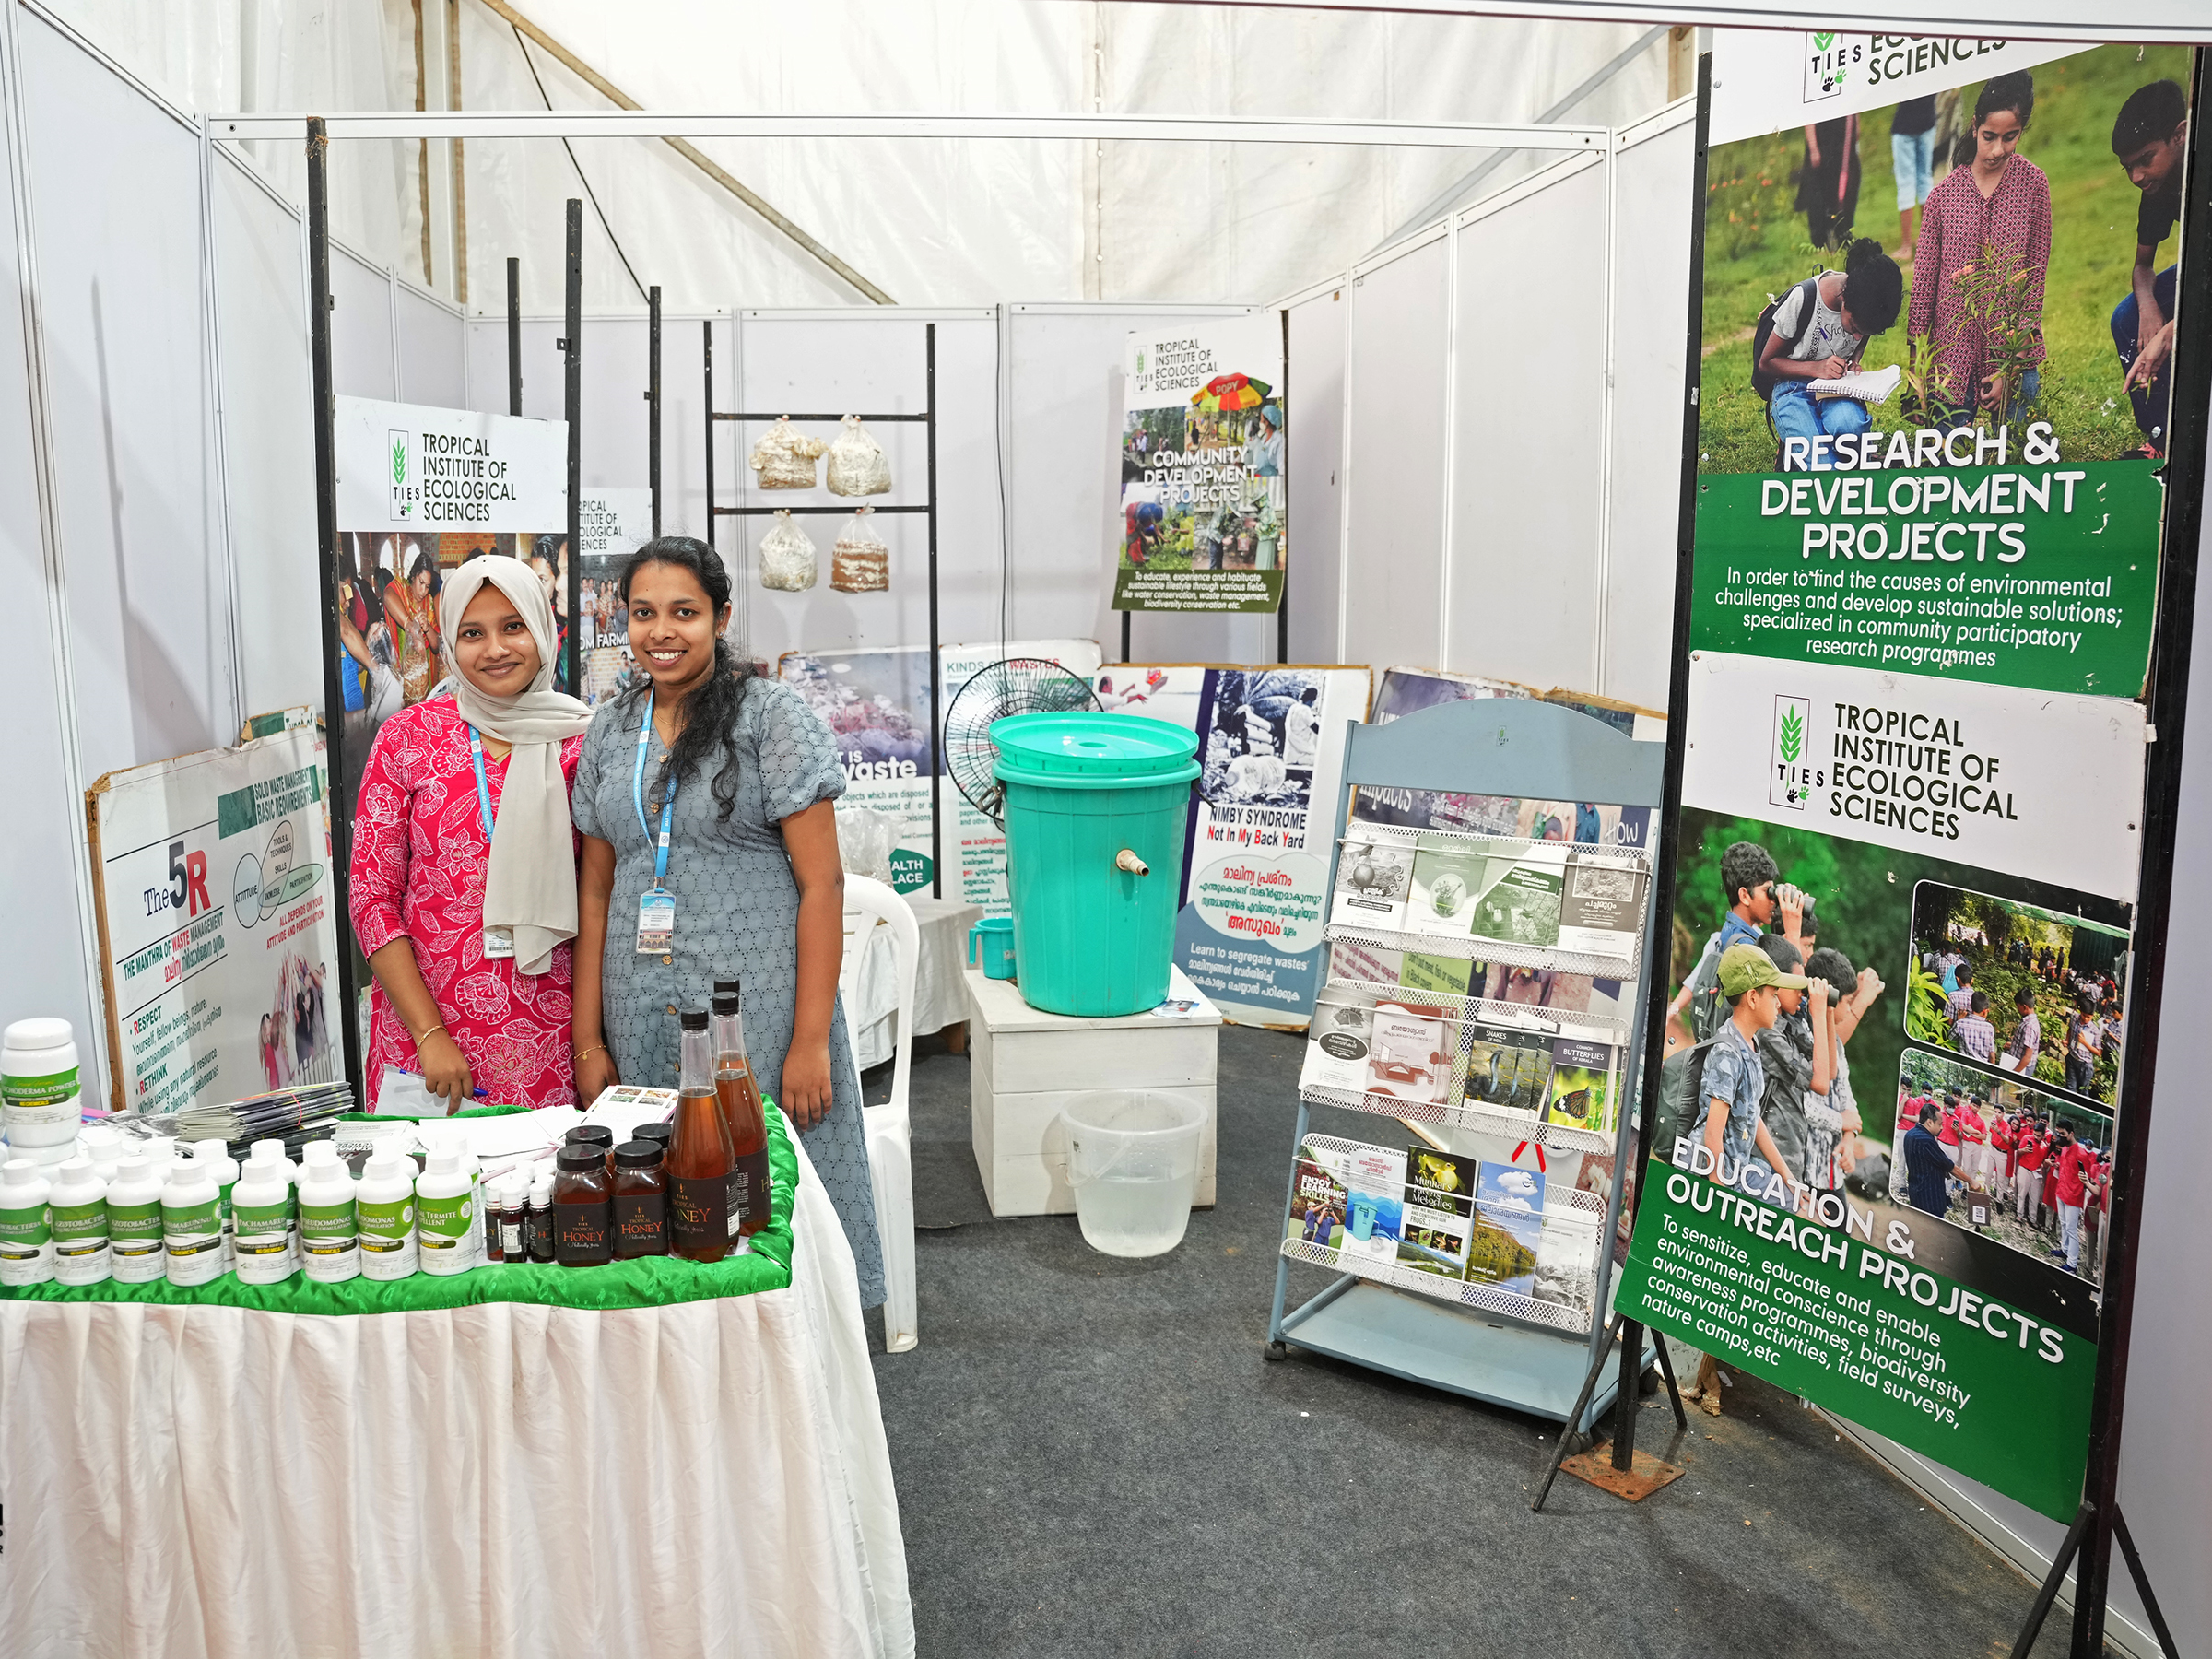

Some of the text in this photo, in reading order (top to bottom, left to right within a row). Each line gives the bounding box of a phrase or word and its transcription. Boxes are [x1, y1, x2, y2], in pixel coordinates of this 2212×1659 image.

[1155, 338, 1199, 354] TROPICAL
[1155, 349, 1212, 366] INSTITUTE OF
[1136, 374, 1153, 382] TIES
[1155, 362, 1218, 379] ECOLOGICAL
[1155, 376, 1200, 391] SCIENCES
[1216, 380, 1240, 394] POPY
[422, 433, 490, 457] TROPICAL
[1152, 446, 1248, 468] COMMUNITY
[1783, 421, 2060, 472] RESEARCH &
[423, 456, 508, 479] INSTITUTE OF
[1144, 465, 1258, 487] DEVELOPMENT
[393, 487, 420, 500] TIES
[424, 479, 516, 501] ECOLOGICAL
[1159, 485, 1241, 504] PROJECTS
[1760, 471, 2086, 516] DEVELOPMENT
[424, 501, 490, 522] SCIENCES
[1802, 522, 2026, 563] PROJECTS
[1127, 582, 1164, 590] sustainable
[1166, 582, 1191, 591] lifestyle
[1192, 582, 1218, 592] through
[1246, 582, 1266, 591] fields
[1135, 571, 1142, 580] To
[1173, 572, 1210, 582] experience
[1212, 572, 1226, 582] and
[1227, 572, 1262, 582] habituate
[1727, 567, 2111, 597] In order to find the causes of environmental
[1144, 600, 1182, 610] biodiversity
[1182, 601, 1226, 609] conservation
[1715, 588, 2123, 629] challenges and develop sustainable solutions;
[1743, 611, 2081, 652] specialized in community participatory
[1806, 637, 1996, 666] research programmes
[1834, 703, 1964, 747] TROPICAL
[848, 750, 863, 763] IS
[1833, 733, 2000, 783] INSTITUTE OF
[254, 767, 309, 800] SOLID WASTE MANAGEMENT
[1777, 763, 1825, 789] TIES
[842, 793, 865, 803] objects
[900, 789, 929, 800] disposed
[1832, 763, 2018, 821] ECOLOGICAL
[257, 786, 313, 824] BASIC REQUIREMENTS
[1830, 791, 1960, 841] SCIENCES
[1209, 806, 1307, 830] NIMBY SYNDROME
[1207, 825, 1305, 849] Not In My Back Yard
[168, 841, 212, 918] 5R
[274, 862, 287, 874] SKILLS
[143, 887, 170, 917] The
[279, 895, 324, 927] ALL DEPENDS ON YOUR
[266, 909, 324, 950] ATTITUDE AND PARTICIPATION
[123, 912, 224, 981] THE MANTHRA OF WASTE MANAGEMENT
[1190, 942, 1308, 971] Learn to segregate wastes
[134, 1005, 162, 1036] RESPECT
[1486, 1030, 1507, 1040] SNAKES
[1562, 1048, 1605, 1061] BUTTERFLIES
[137, 1094, 154, 1115] While
[154, 1085, 170, 1104] using
[170, 1077, 180, 1096] any
[179, 1061, 197, 1084] natural
[196, 1046, 218, 1070] resource
[139, 1063, 168, 1096] RETHINK
[1300, 1182, 1346, 1199] LEARNING
[1301, 1175, 1331, 1188] ENJOY
[1300, 1190, 1330, 1202] SKILLS
[1412, 1194, 1452, 1210] Melodies
[1672, 1135, 1917, 1260] EDUCATION &
[563, 1230, 605, 1241] HONEY
[621, 1222, 662, 1234] HONEY
[1662, 1214, 1941, 1347] To sensitize, educate and enable
[1666, 1173, 2065, 1365] OUTREACH PROJECTS
[1641, 1293, 1692, 1325] nature
[1657, 1237, 1946, 1375] environmental conscience through
[1653, 1257, 1971, 1410] awareness programmes, biodiversity
[1647, 1274, 1960, 1429] conservation activities, field surveys,
